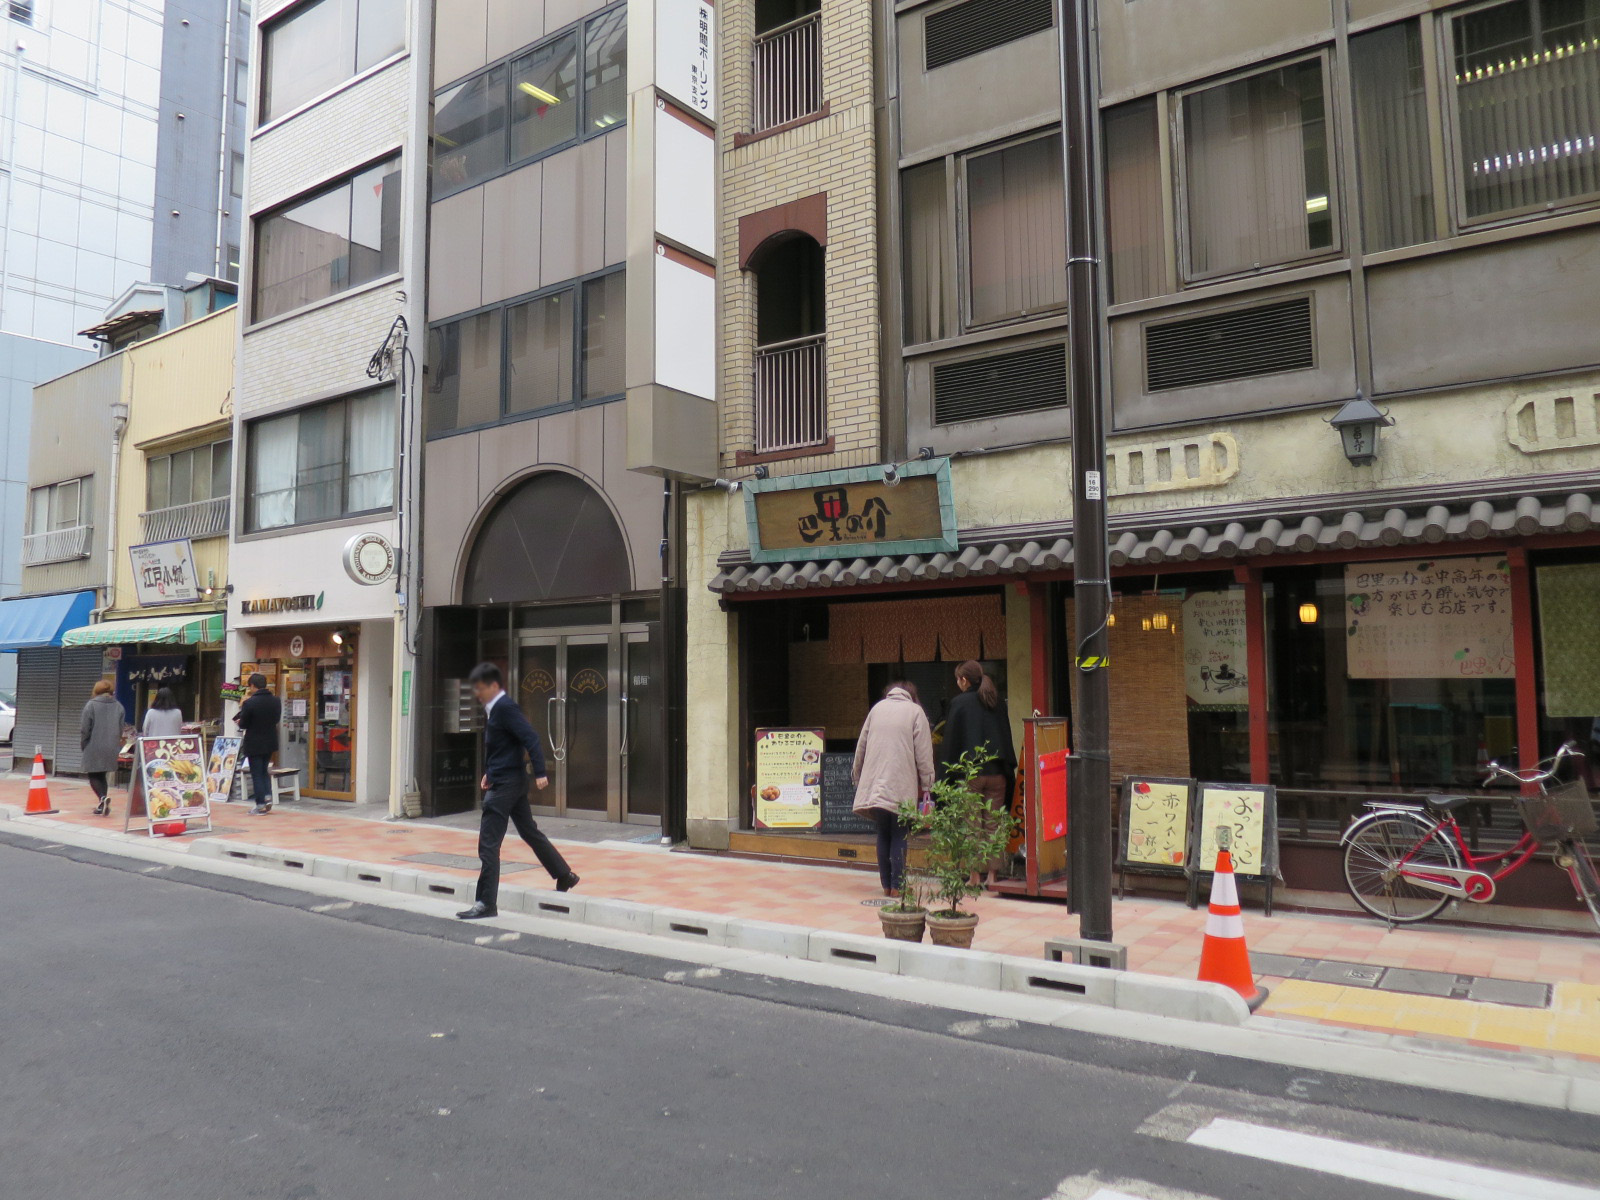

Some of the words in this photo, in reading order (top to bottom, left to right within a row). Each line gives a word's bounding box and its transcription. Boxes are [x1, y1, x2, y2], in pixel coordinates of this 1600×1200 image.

[1371, 585, 1509, 602] 方がほろ酔い気分で
[241, 595, 315, 614] KAMAYOSHI
[155, 738, 194, 761] うどん
[1162, 792, 1180, 851] 赤ワイン
